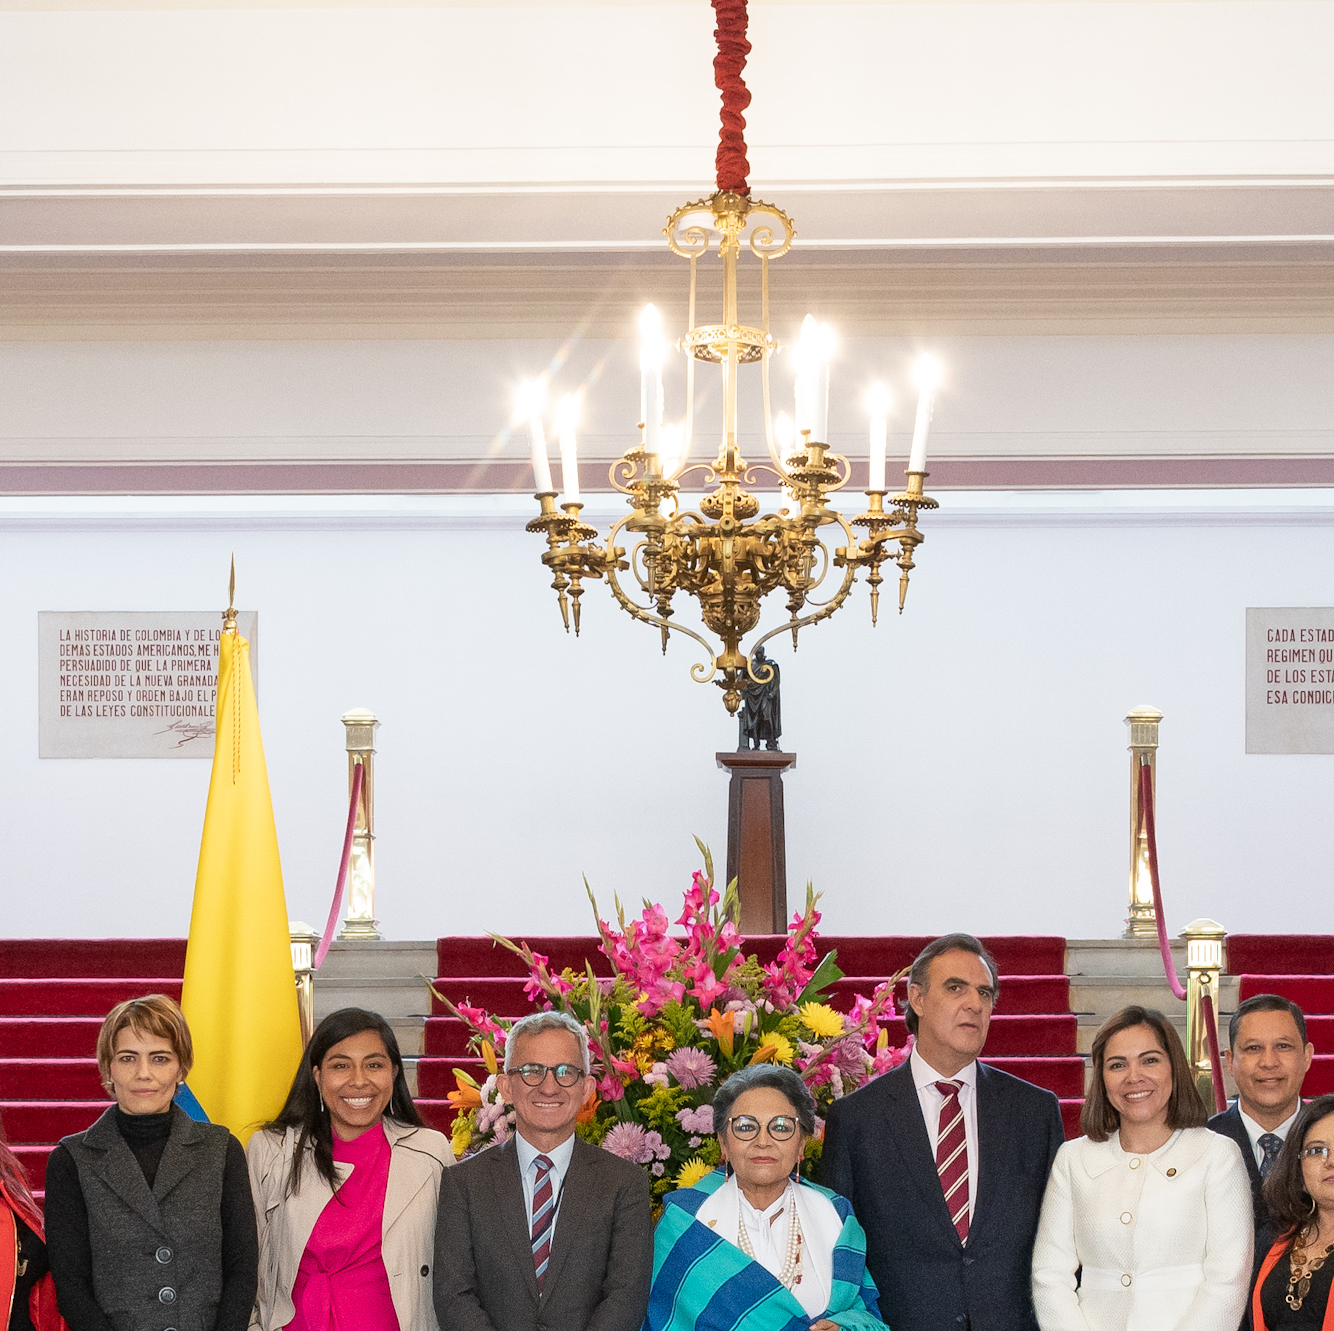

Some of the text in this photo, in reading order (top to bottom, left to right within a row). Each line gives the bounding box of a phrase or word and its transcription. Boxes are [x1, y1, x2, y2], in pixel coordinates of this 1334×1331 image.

[59, 629, 221, 642] LA HISTORIA DE COLOMBIA Y DE LO
[1267, 628, 1296, 643] CADA
[59, 643, 91, 657] DEMAS
[93, 643, 133, 657] ESTADOS
[197, 643, 211, 657] ME
[1266, 648, 1316, 663] REGIMEN
[59, 659, 212, 673] PERSUADIDO DE QUE LA PRIMERA
[60, 674, 219, 687] NECESIDAD DE LA NUEVA GRANADA
[1266, 669, 1281, 684] DE
[1285, 669, 1307, 684] LOS
[60, 689, 84, 702] ERAN
[87, 689, 124, 702] REPOSO
[127, 689, 133, 702] Y
[136, 689, 166, 702] ORDEN
[169, 689, 194, 702] BAJO
[197, 689, 209, 702] EL
[1266, 690, 1289, 705] ESA
[60, 704, 216, 717] DE LAS LEYES CONSTITUCIONALE
